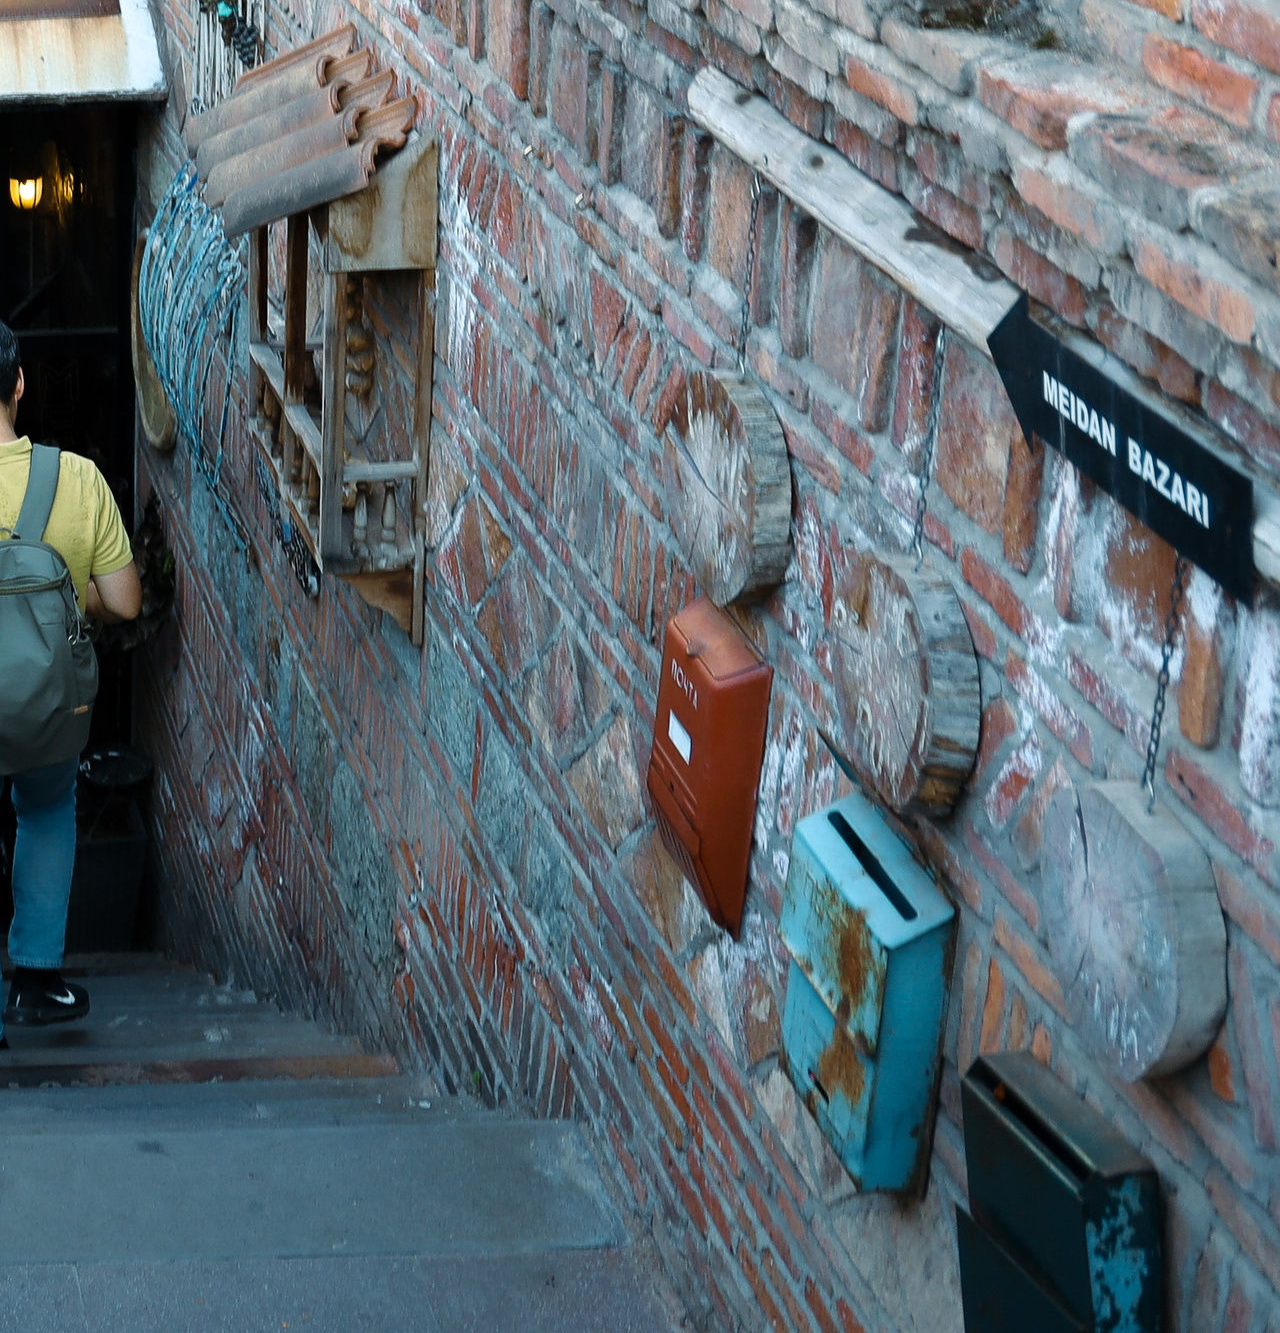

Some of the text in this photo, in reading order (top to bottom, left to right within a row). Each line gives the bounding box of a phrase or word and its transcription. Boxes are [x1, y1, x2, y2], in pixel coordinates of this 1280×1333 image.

[1043, 370, 1210, 530] MEIDAN BAZARI
[671, 658, 698, 712] ПОЧТА
